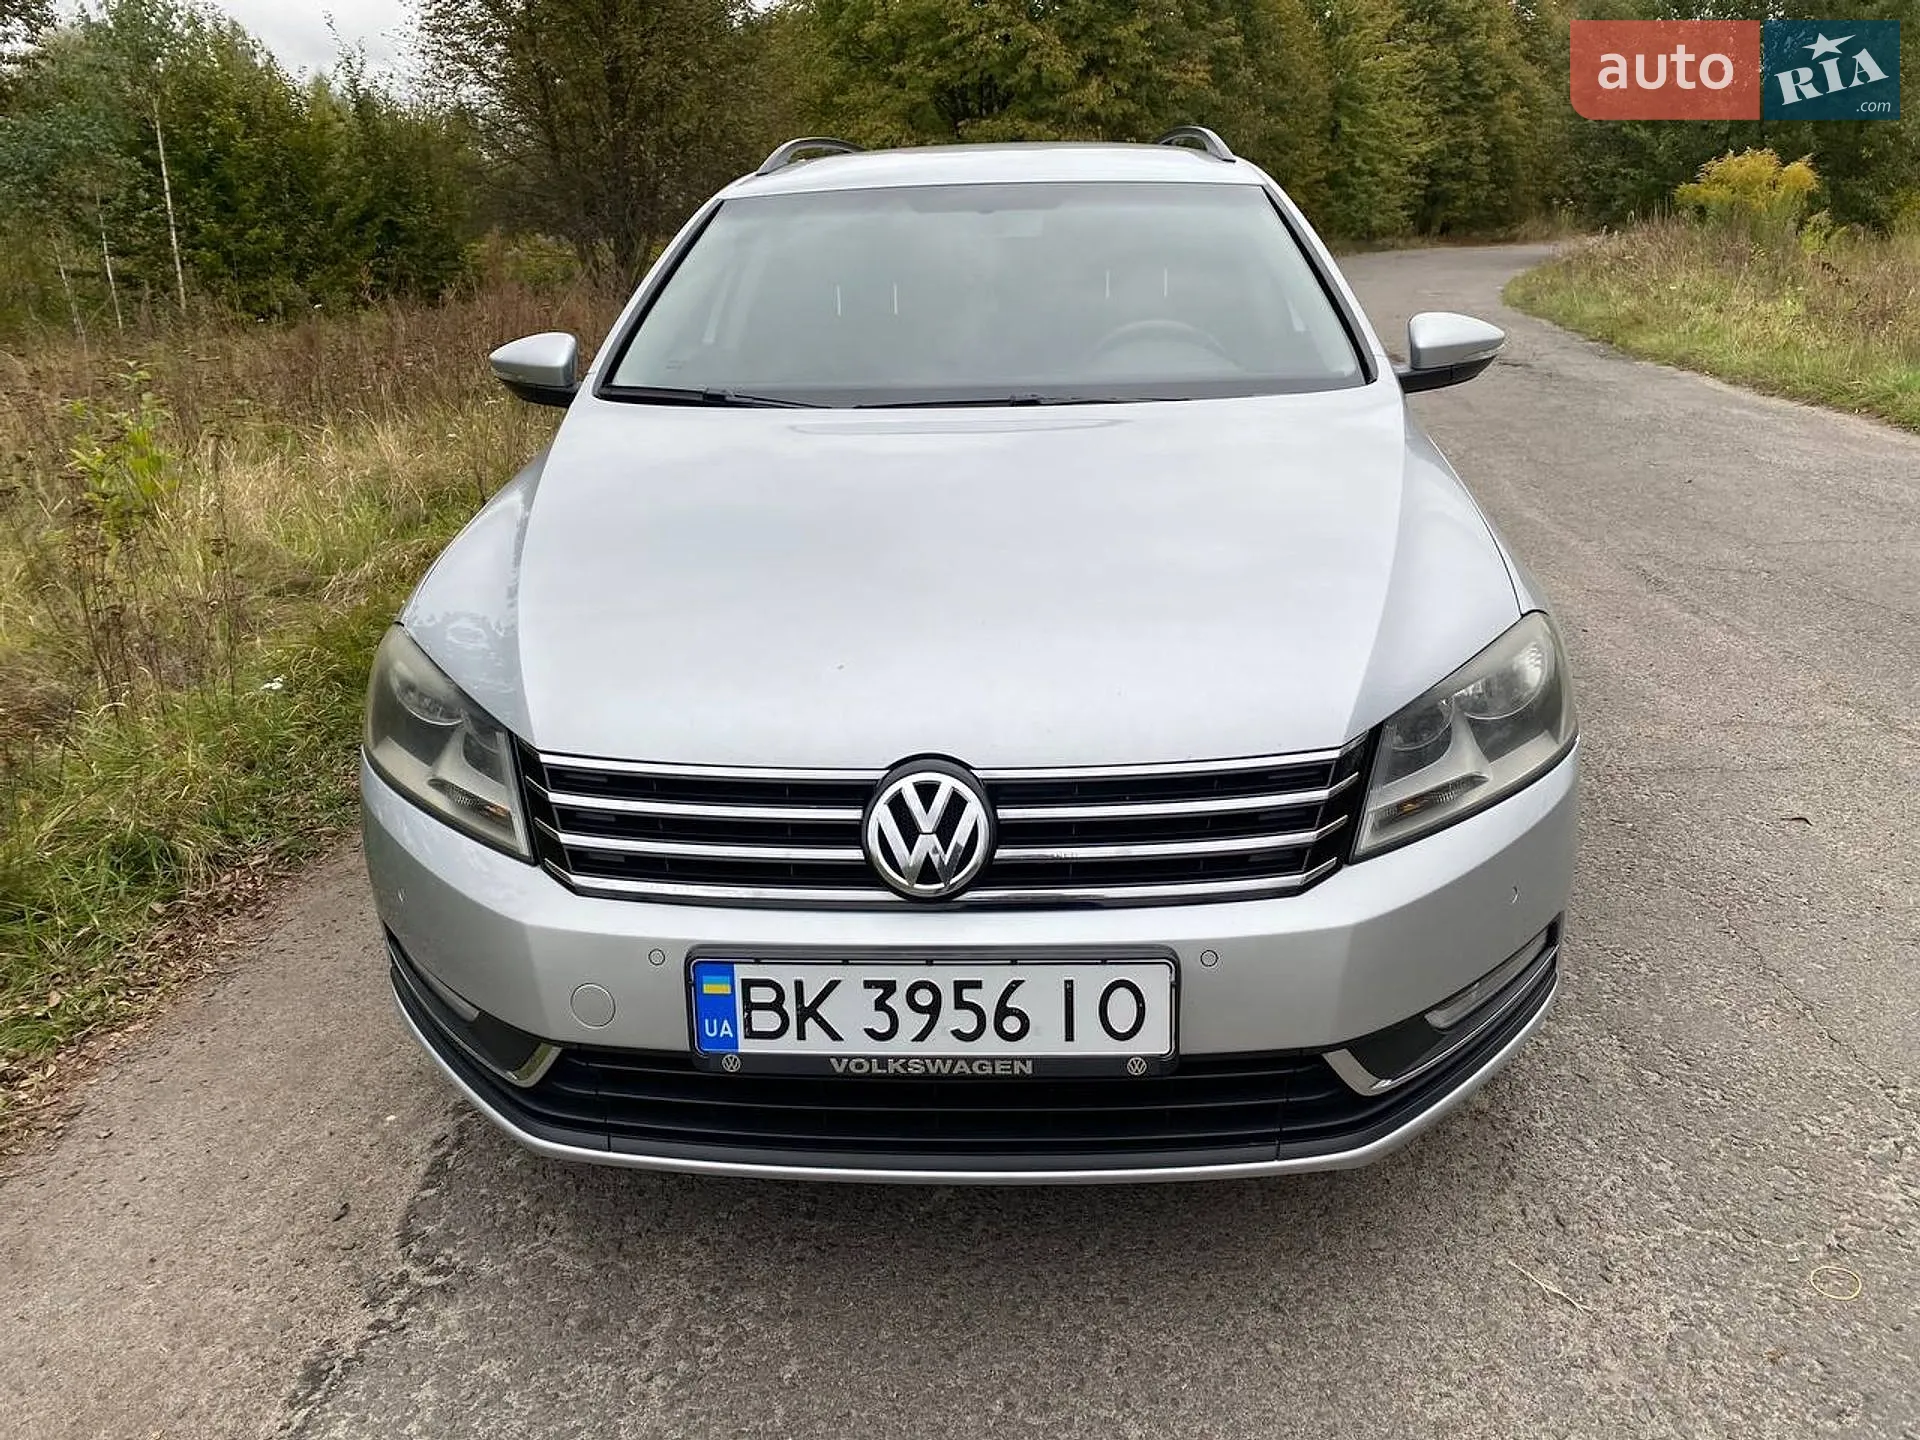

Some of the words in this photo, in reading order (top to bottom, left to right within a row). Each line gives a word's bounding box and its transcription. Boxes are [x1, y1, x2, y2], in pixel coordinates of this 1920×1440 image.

[741, 978, 845, 1042] BK
[862, 978, 1032, 1042] 3956
[1063, 978, 1146, 1042] IO
[704, 1018, 733, 1038] UA
[829, 1057, 1033, 1075] VOLKSWAGEN
